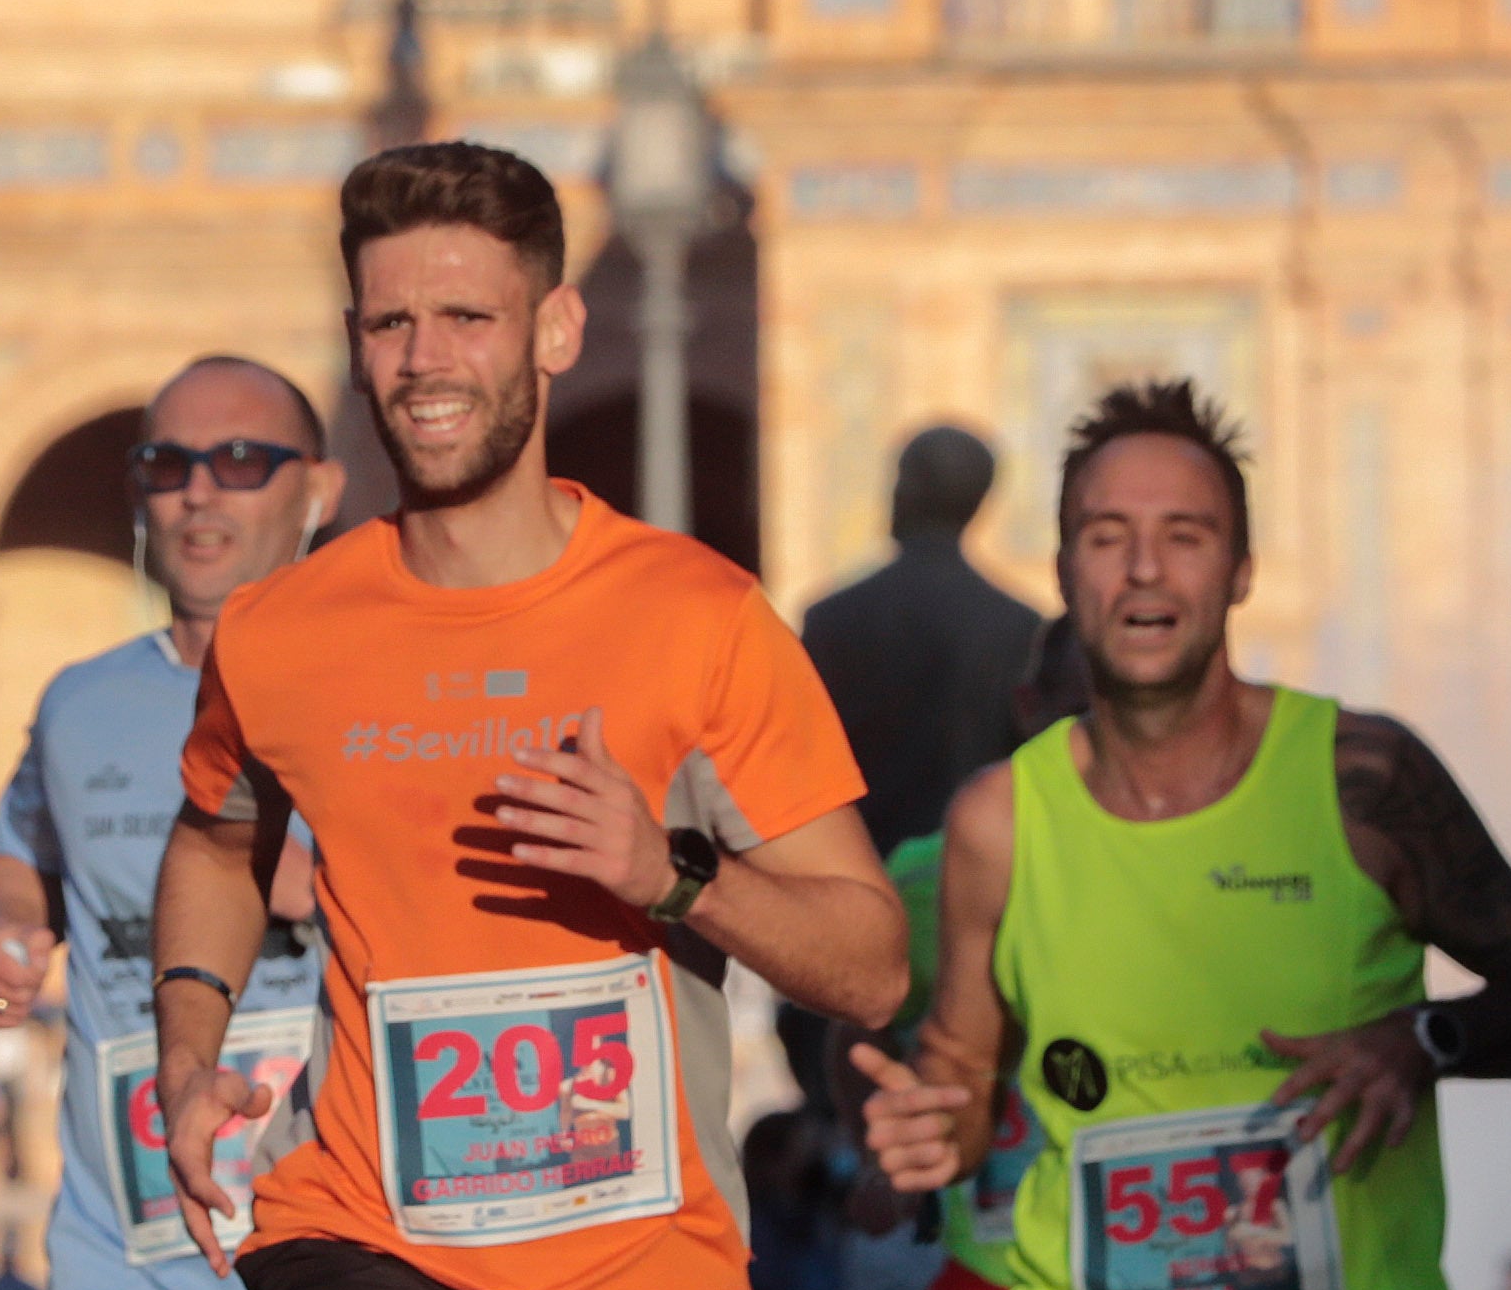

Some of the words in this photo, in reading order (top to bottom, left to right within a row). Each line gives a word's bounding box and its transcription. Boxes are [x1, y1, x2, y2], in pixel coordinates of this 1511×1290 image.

[413, 1011, 635, 1122] 205
[463, 1140, 528, 1163] JUAN
[412, 1172, 536, 1202] GARRIDO
[1105, 1148, 1291, 1245] 557
